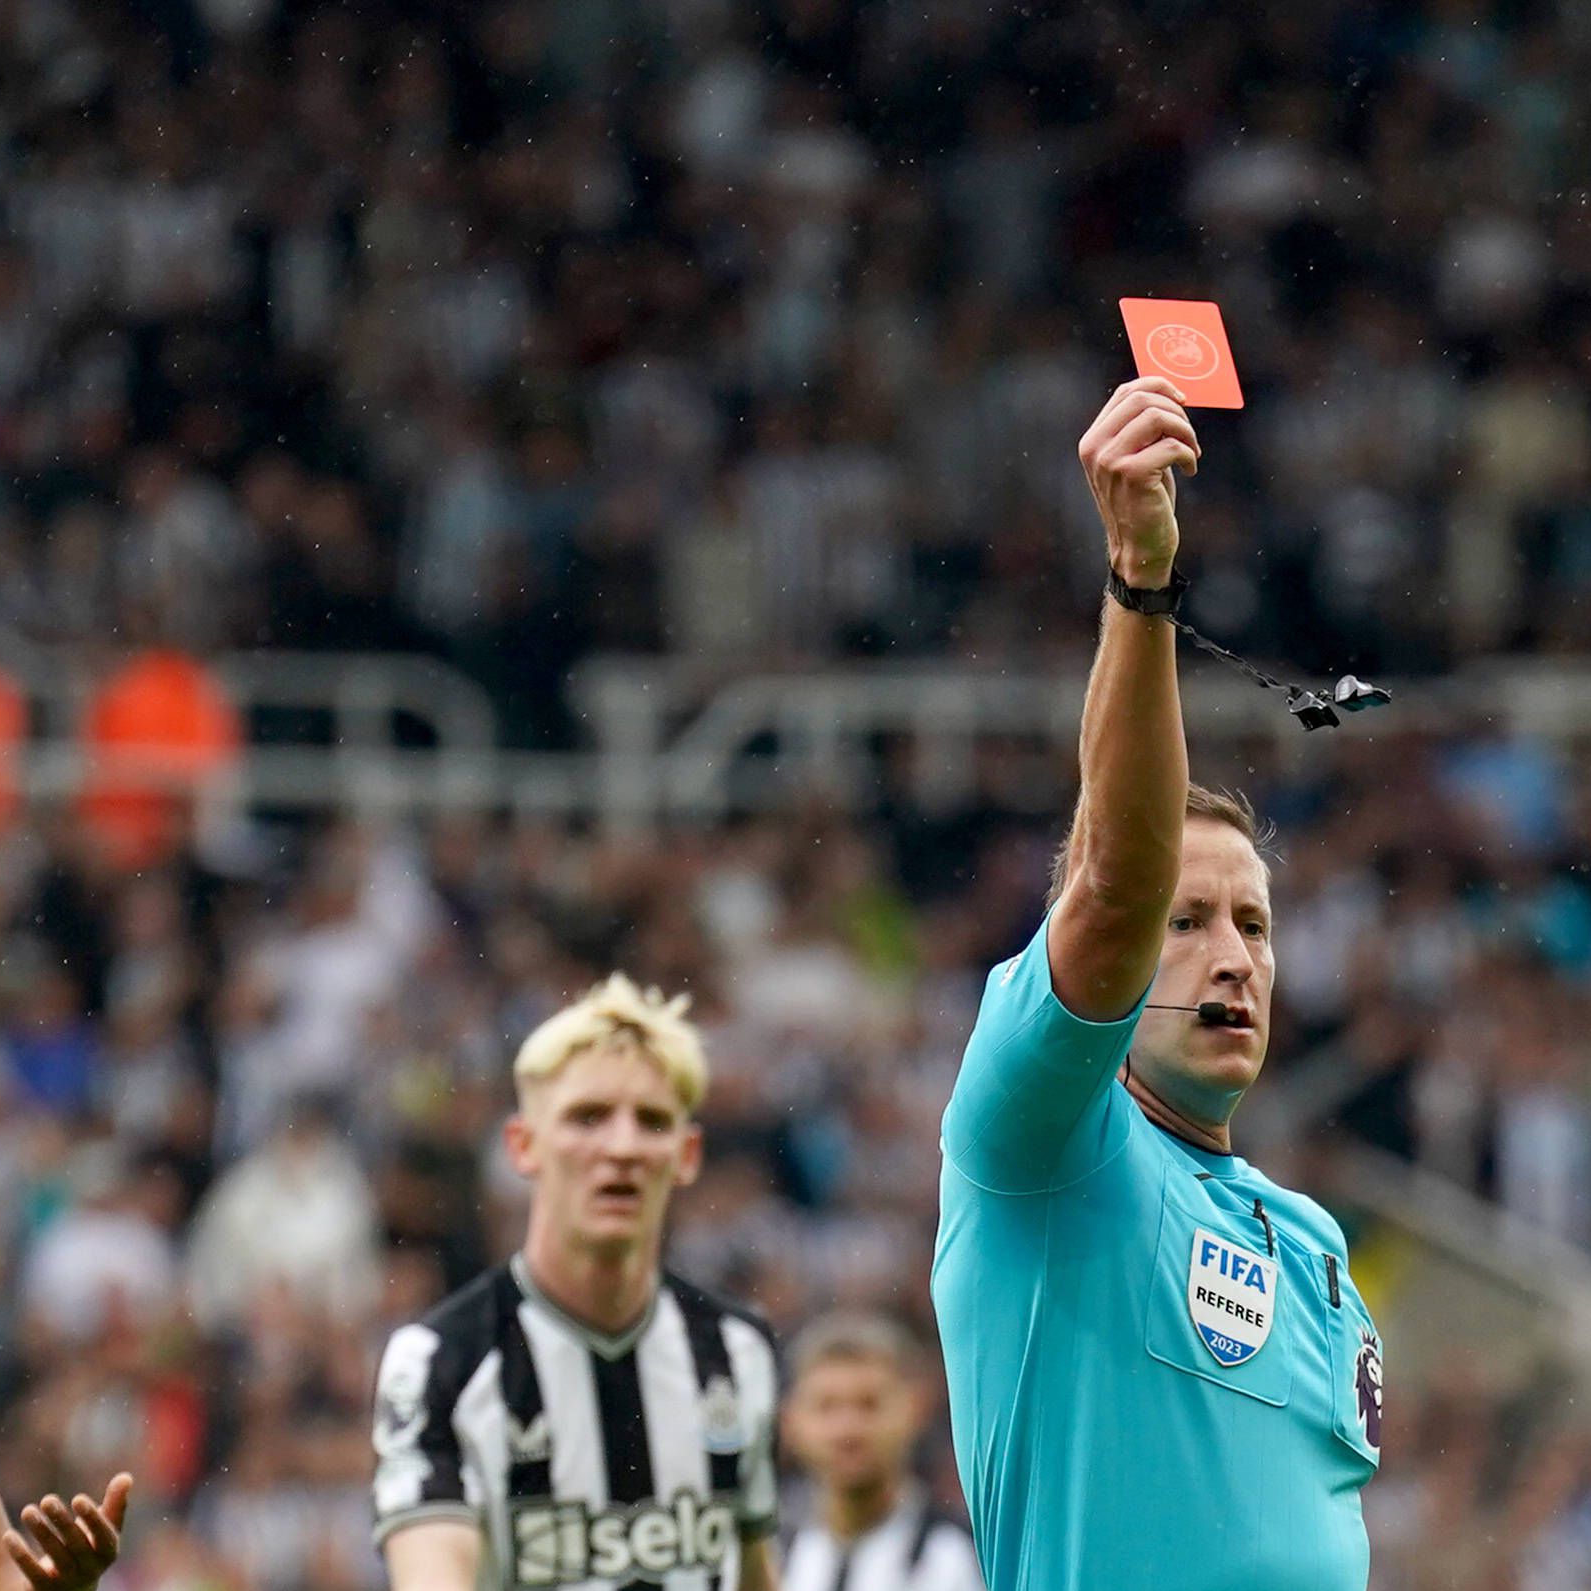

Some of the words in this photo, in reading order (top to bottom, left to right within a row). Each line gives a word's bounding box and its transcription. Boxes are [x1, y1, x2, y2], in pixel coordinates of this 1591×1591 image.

[1157, 328, 1198, 342] UEFA
[1200, 1239, 1267, 1295] FIFA
[1196, 1286, 1264, 1328] REFEREE
[1210, 1332, 1242, 1357] 2023
